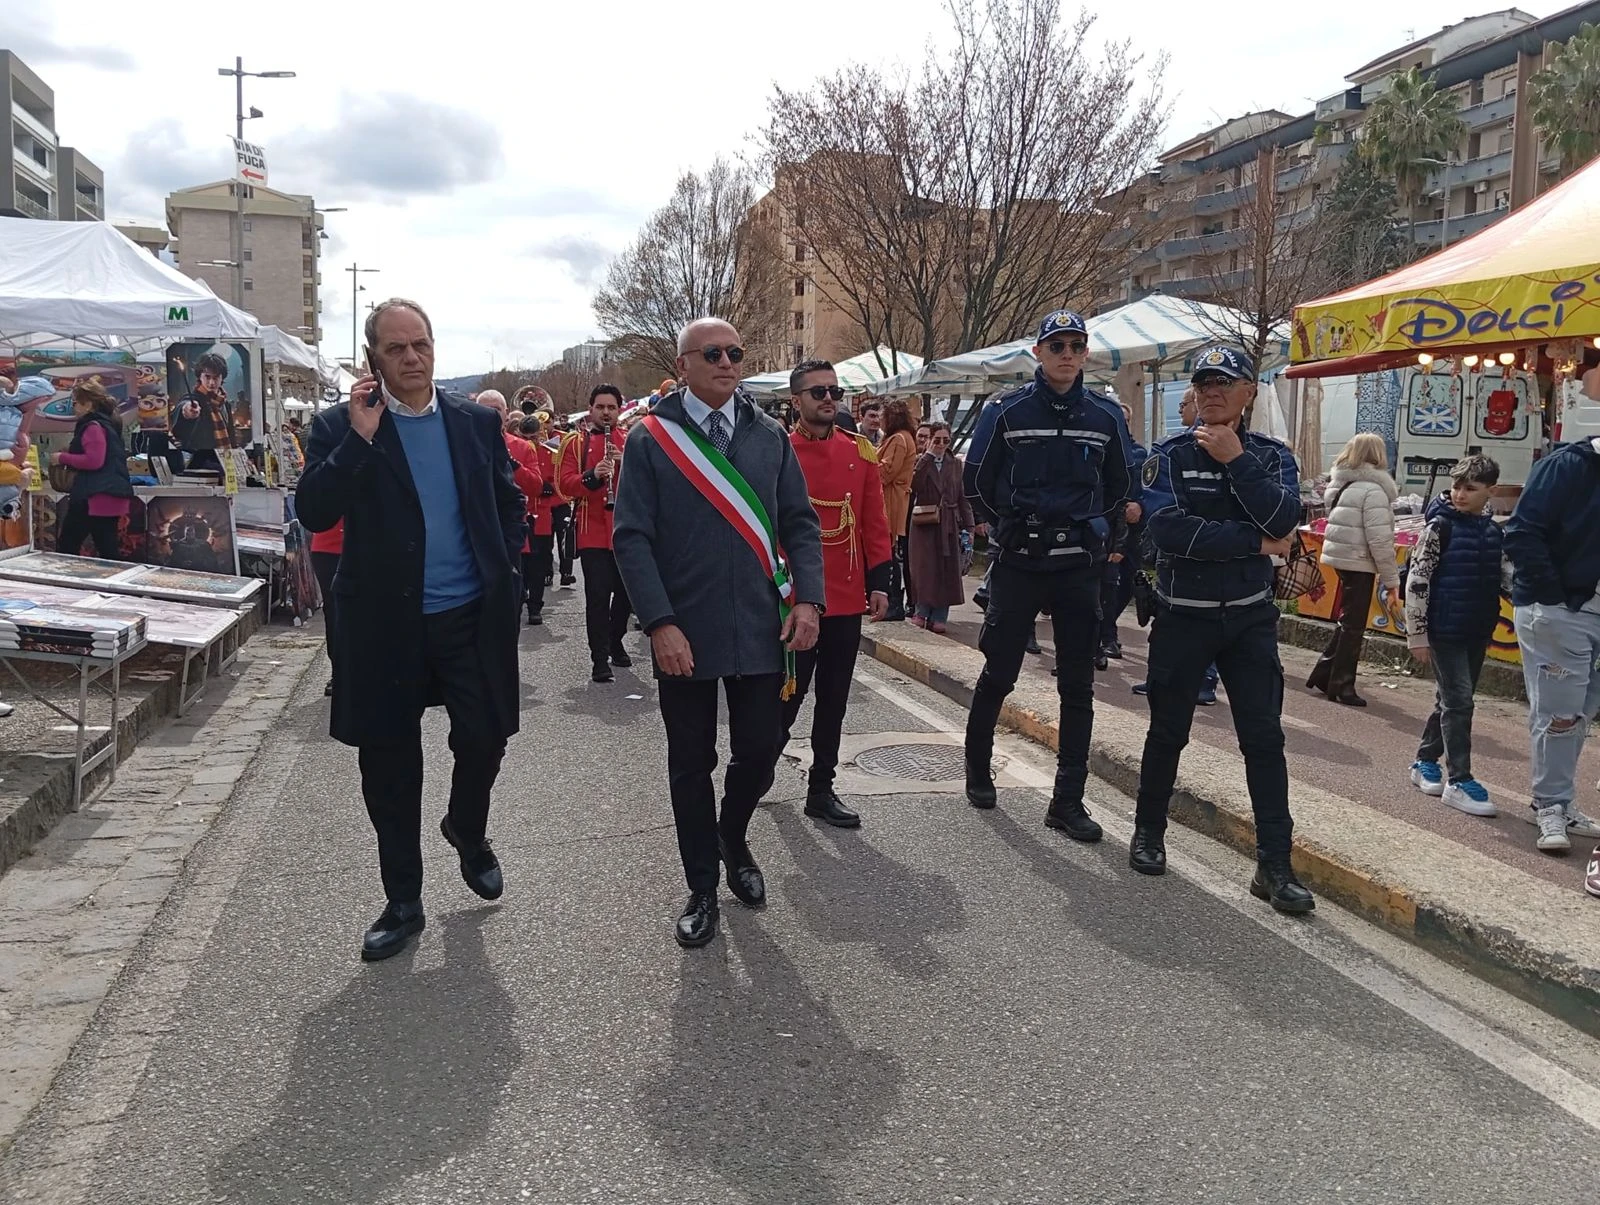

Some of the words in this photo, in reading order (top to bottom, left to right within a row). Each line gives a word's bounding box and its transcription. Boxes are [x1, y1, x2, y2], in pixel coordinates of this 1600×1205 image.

[233, 138, 253, 154] VIA
[252, 145, 264, 157] DI
[237, 152, 266, 170] FUGA
[168, 306, 189, 321] M
[1044, 312, 1062, 332] POLIZIA
[1063, 311, 1083, 329] LOCALE
[1195, 347, 1217, 370] POLIZIA
[1217, 346, 1239, 368] LOCALE
